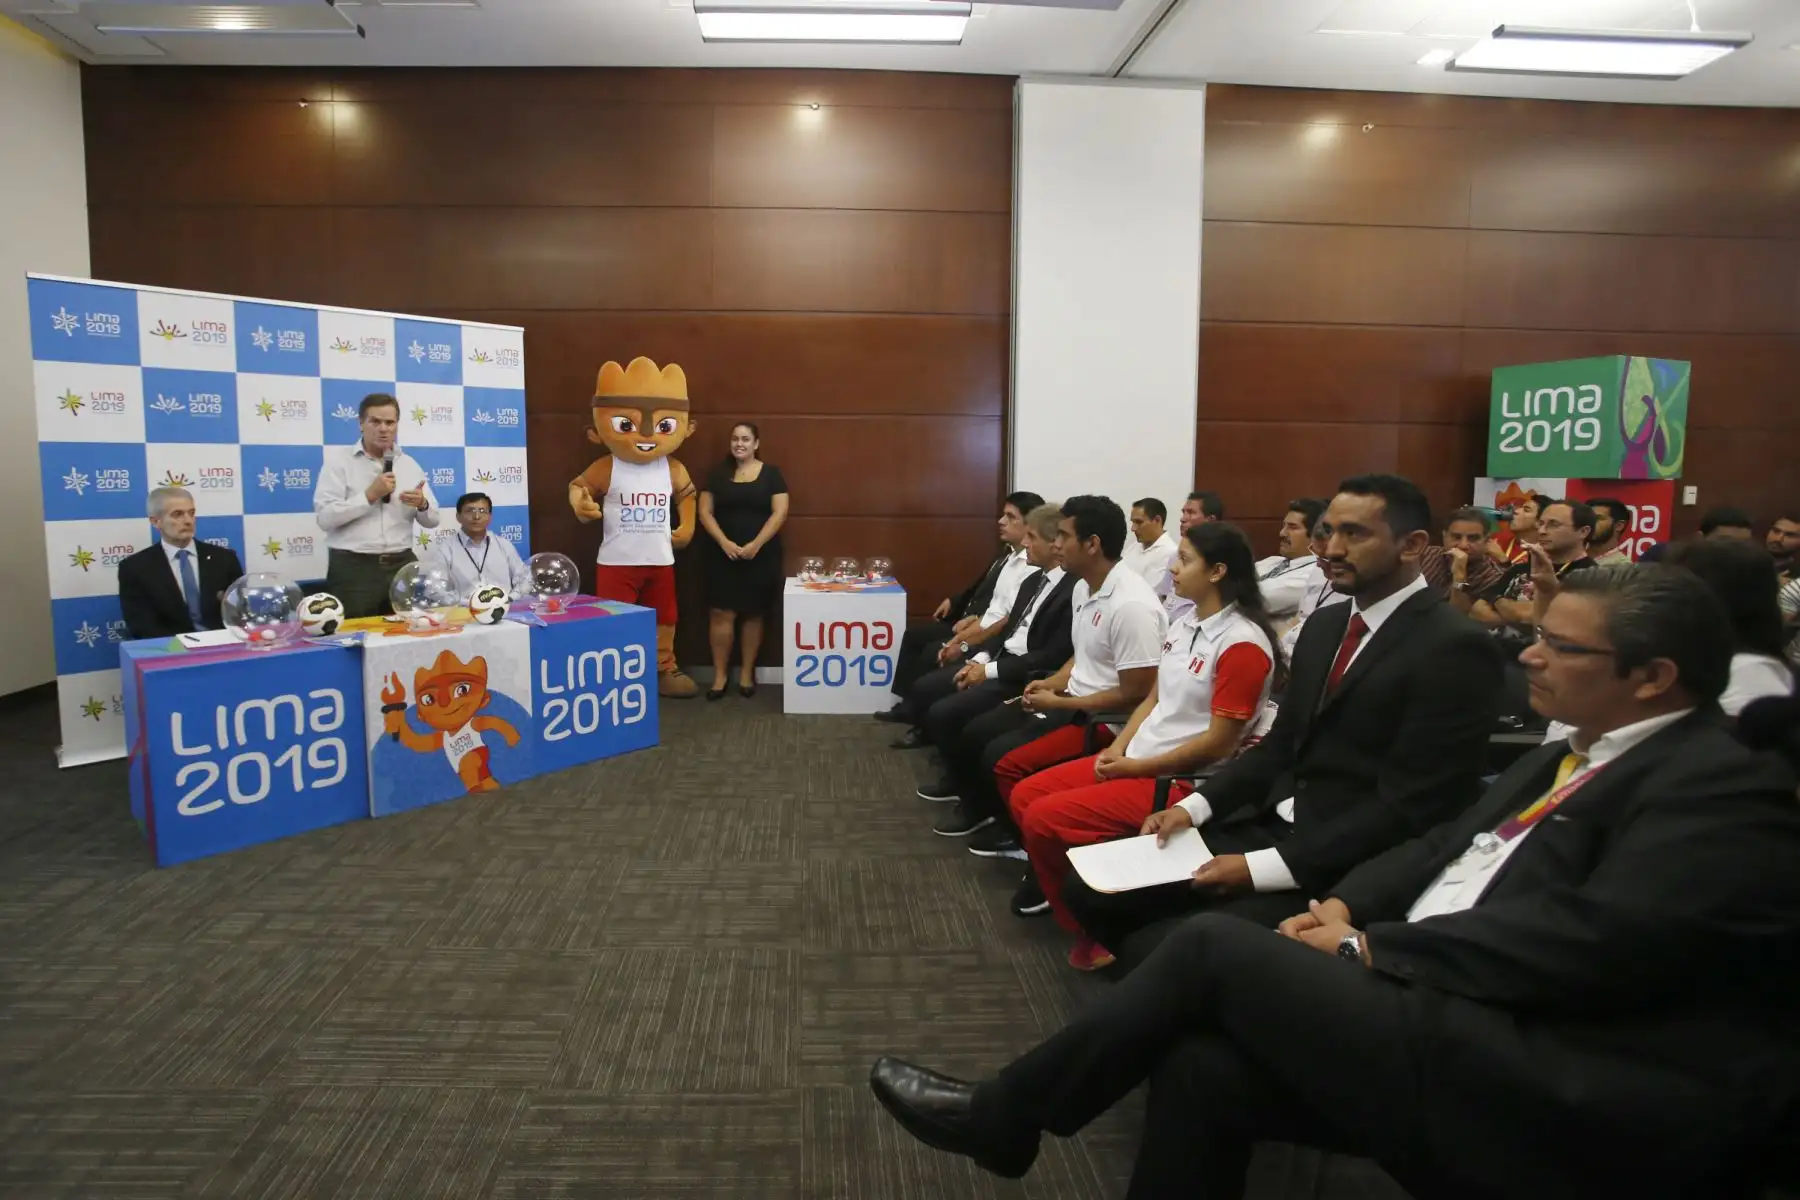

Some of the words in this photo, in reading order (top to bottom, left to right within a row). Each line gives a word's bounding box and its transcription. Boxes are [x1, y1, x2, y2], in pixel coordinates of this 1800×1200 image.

[86, 321, 121, 334] 2019
[192, 331, 227, 344] 2019
[278, 337, 305, 349] 2019
[360, 345, 386, 356] 2019
[428, 350, 452, 362] 2019
[496, 356, 519, 367] 2019
[91, 401, 125, 412] 2019
[189, 402, 222, 414] 2019
[281, 408, 308, 419] 2019
[431, 413, 452, 423] 2019
[497, 415, 519, 425] 2019
[1499, 417, 1601, 452] 2019
[96, 477, 130, 489] 2019
[200, 477, 234, 488] 2019
[284, 476, 311, 486] 2019
[432, 475, 455, 484] 2019
[499, 473, 522, 483] 2019
[620, 507, 667, 523] 2019
[287, 543, 314, 554] 2019
[795, 654, 893, 687] 2019
[542, 683, 646, 741] 2019
[175, 737, 347, 816] 2019
